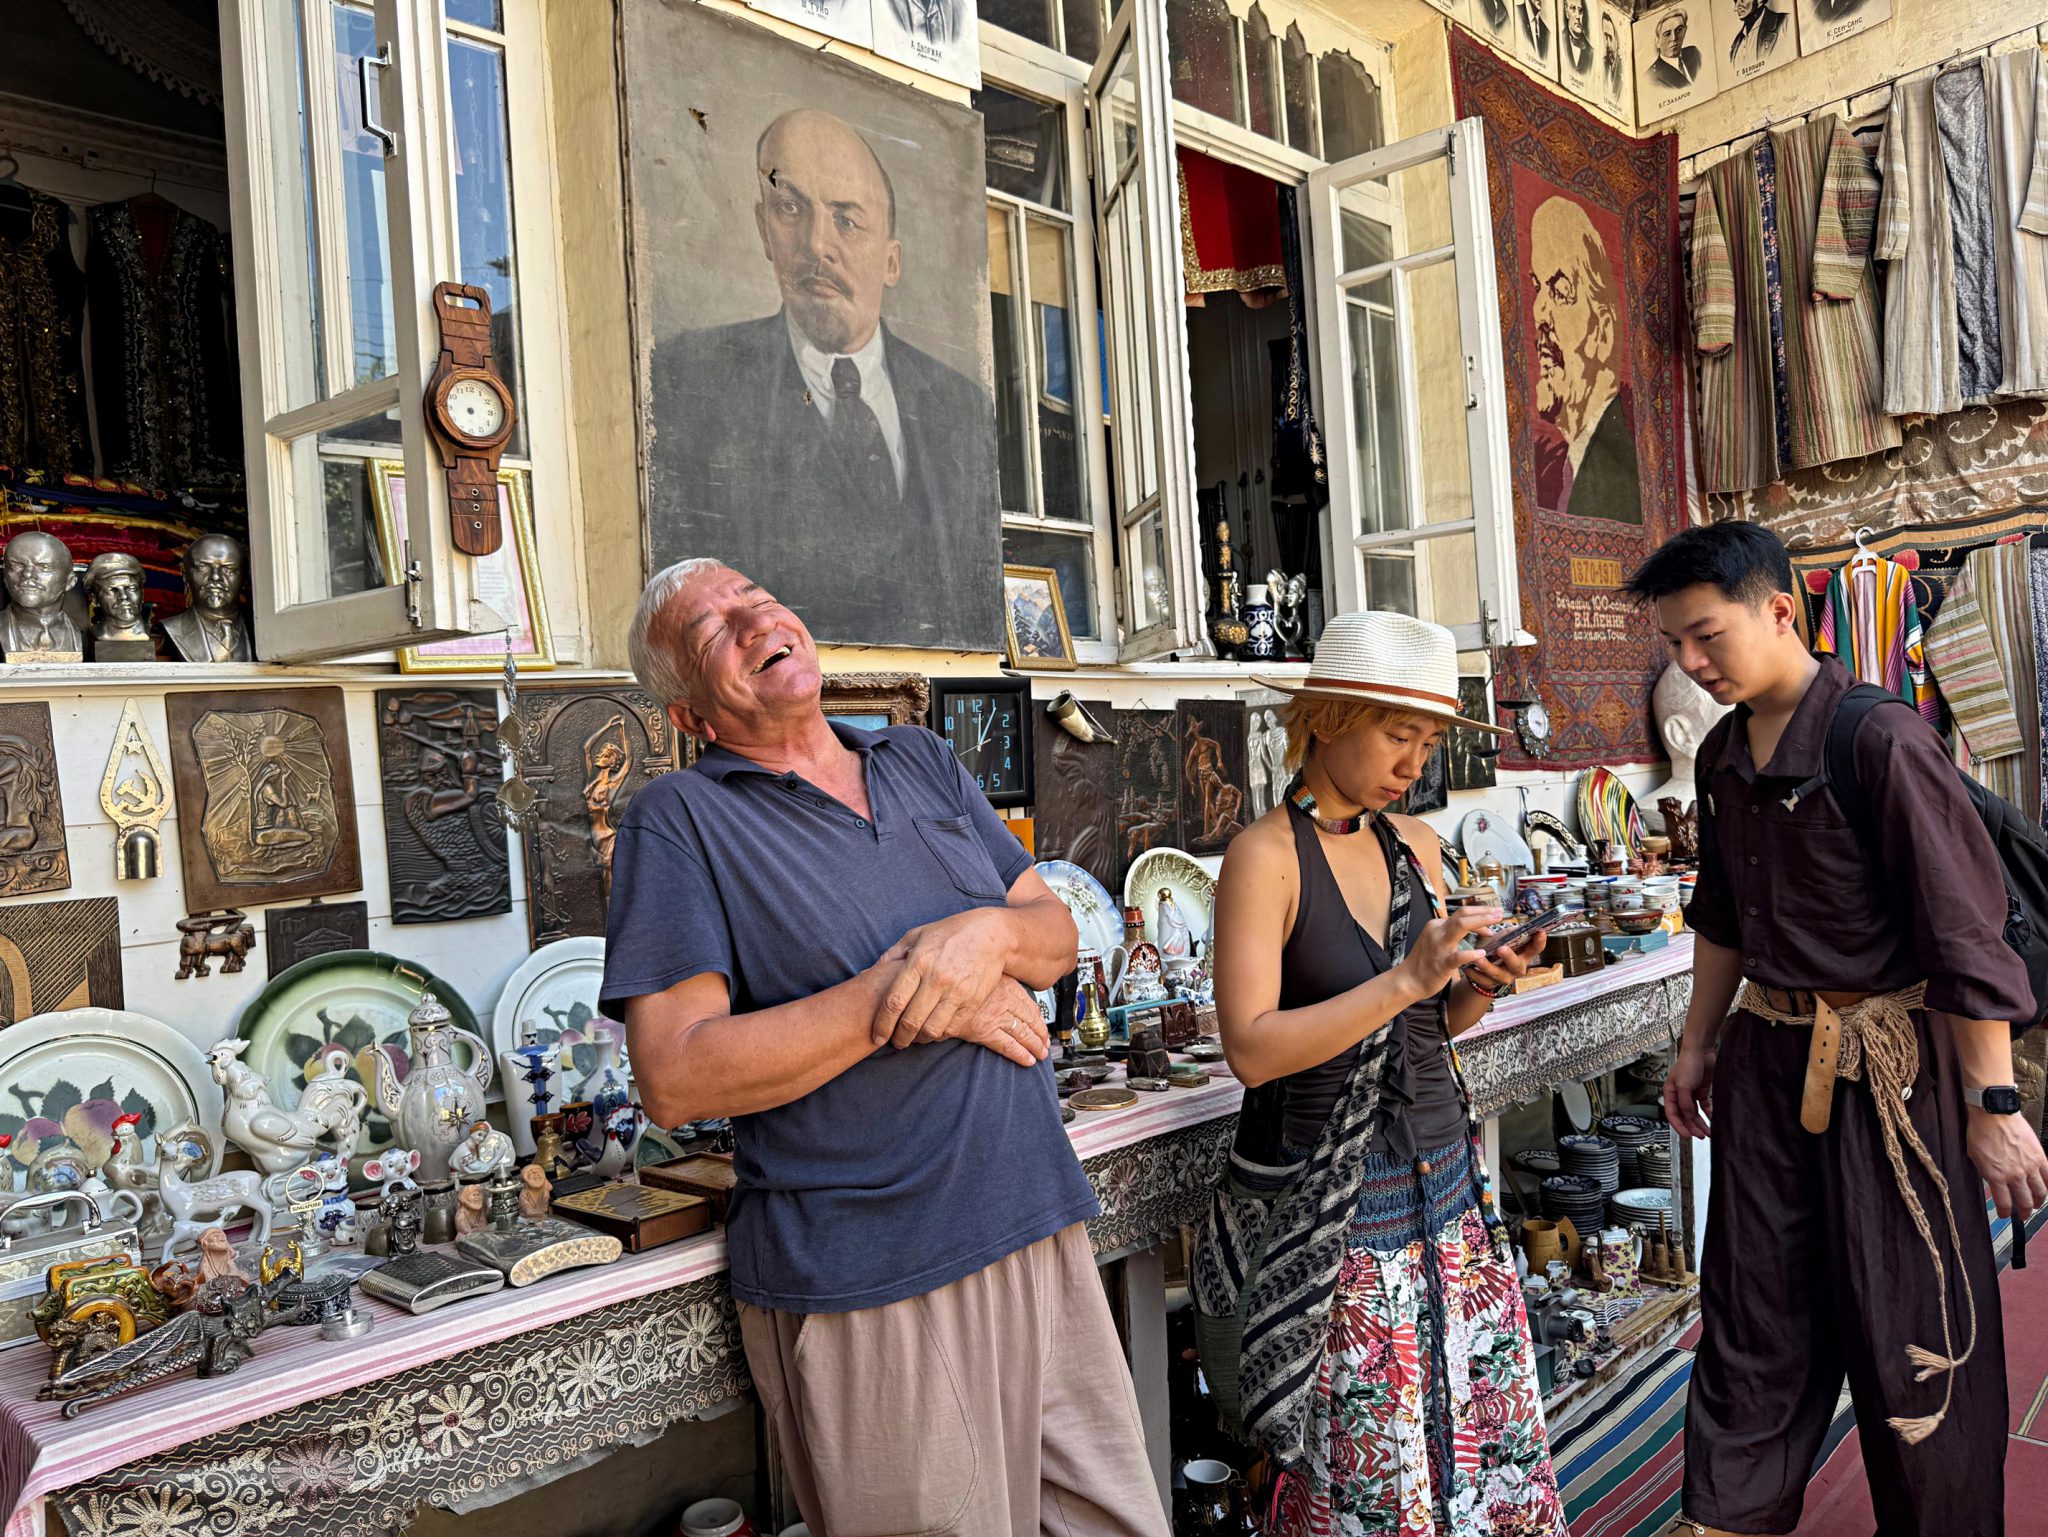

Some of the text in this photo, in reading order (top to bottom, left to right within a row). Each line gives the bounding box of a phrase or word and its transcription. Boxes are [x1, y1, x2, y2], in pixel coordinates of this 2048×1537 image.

[1833, 17, 1863, 35] СЕН-САНС
[1572, 560, 1620, 584] 1870-1970
[957, 700, 965, 714] 11
[972, 699, 983, 713] 12
[944, 716, 954, 731] 10
[1002, 714, 1010, 728] 2
[946, 739, 954, 751] 9
[1003, 735, 1011, 749] 3
[1004, 757, 1011, 770] 4
[976, 774, 985, 789] 6
[993, 773, 1001, 787] 5
[292, 1202, 321, 1211] SINGAPORE
